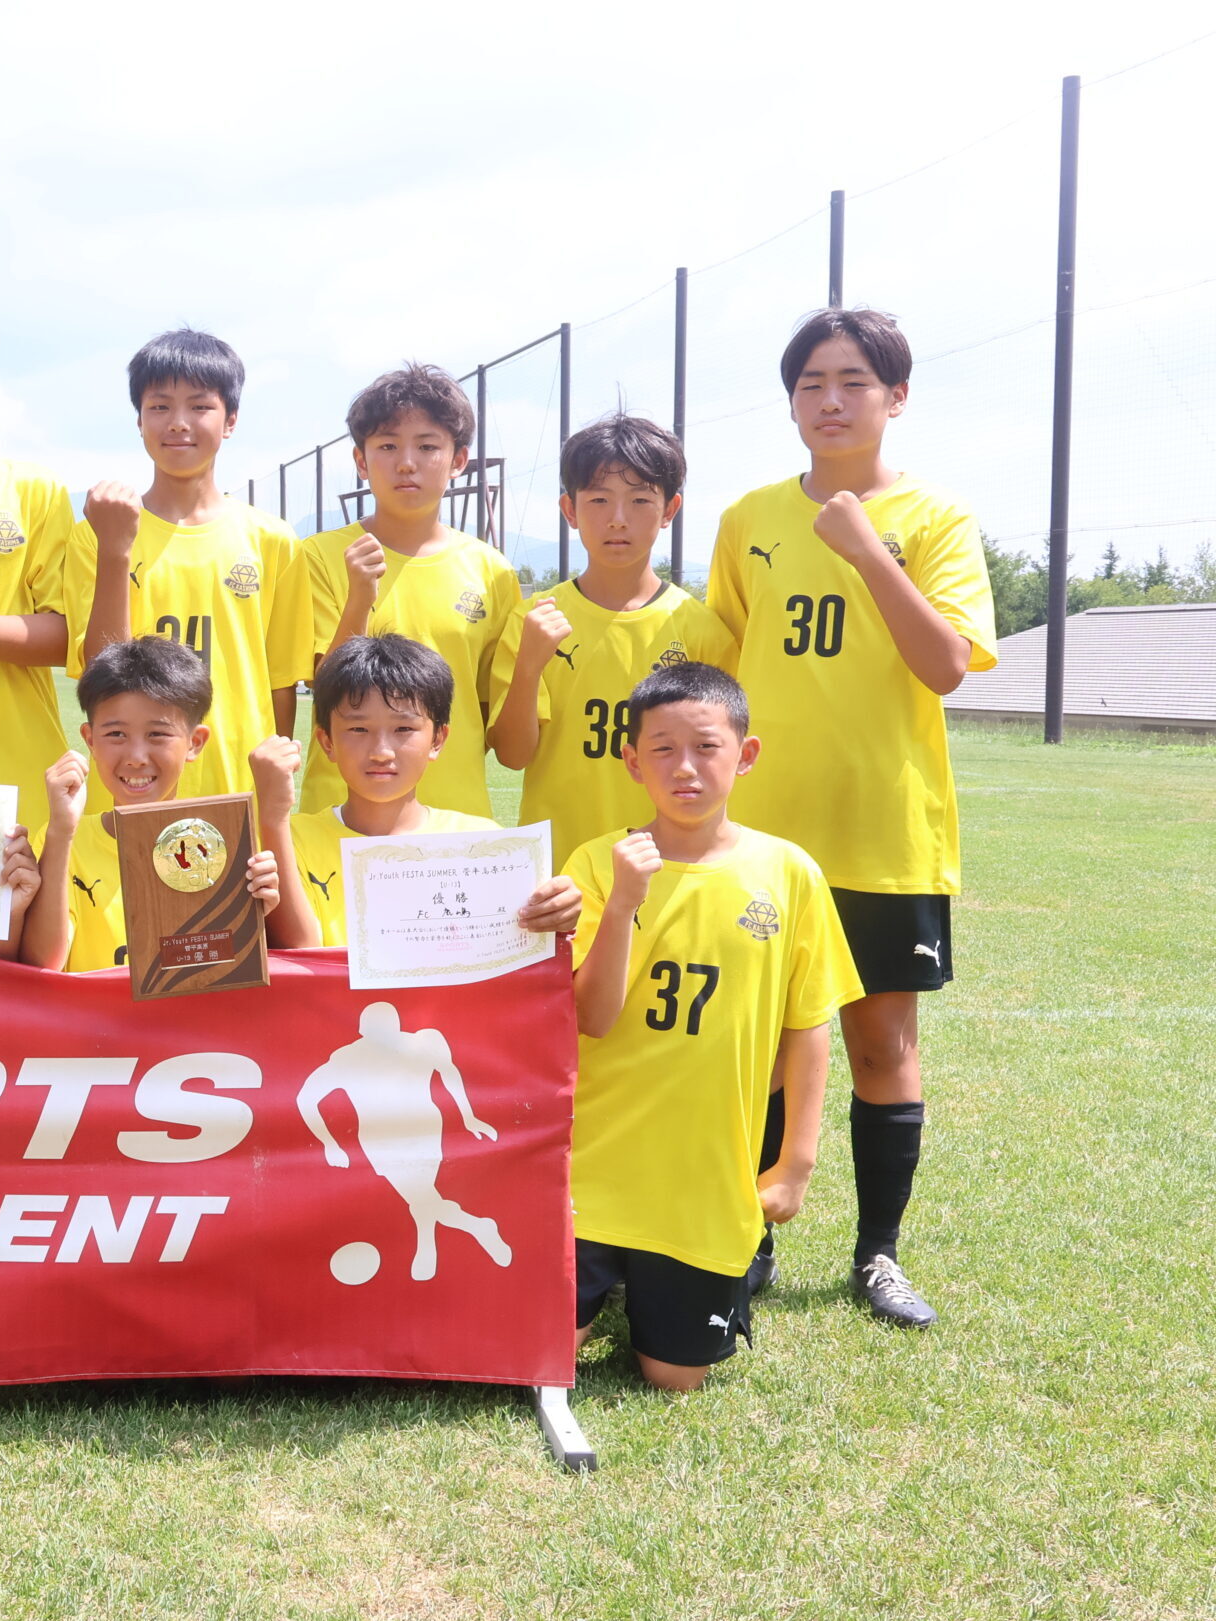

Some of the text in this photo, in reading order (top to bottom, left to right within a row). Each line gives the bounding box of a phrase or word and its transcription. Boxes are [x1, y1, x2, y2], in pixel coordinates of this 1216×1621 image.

[784, 594, 846, 657] 30
[583, 698, 629, 759] 38
[402, 870, 424, 878] FESTA
[427, 869, 457, 878] SUMMER
[645, 960, 720, 1036] 37
